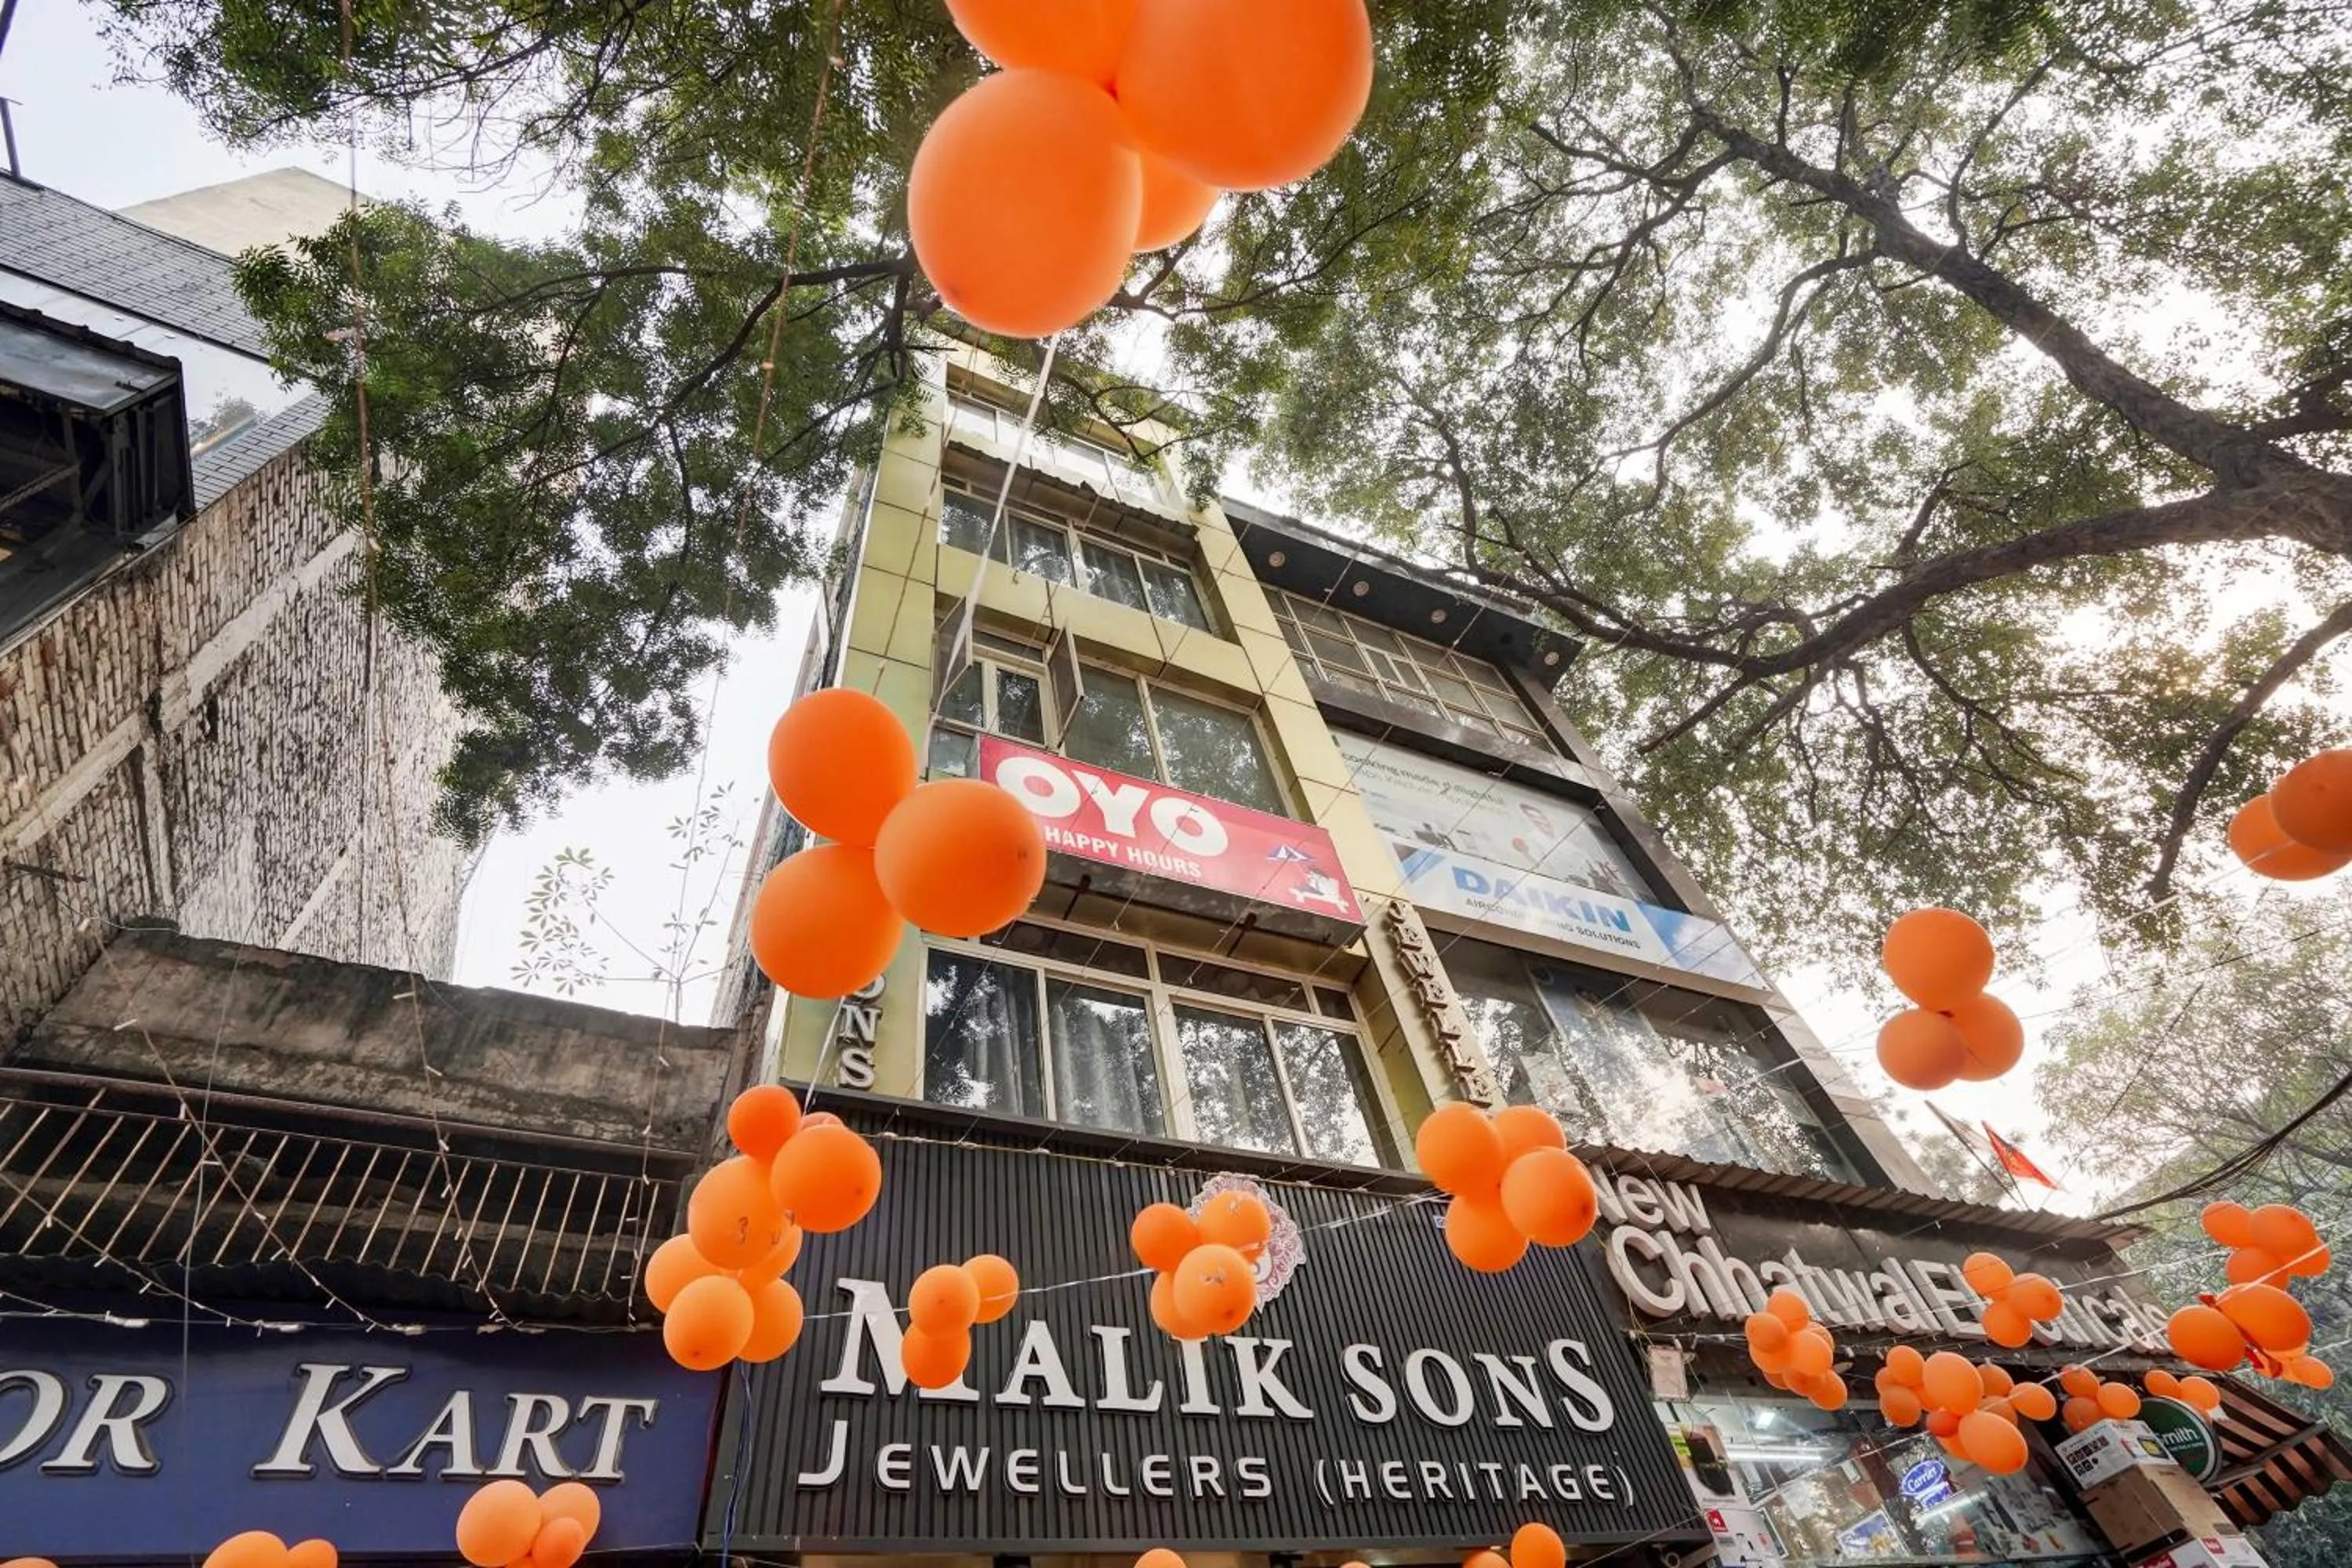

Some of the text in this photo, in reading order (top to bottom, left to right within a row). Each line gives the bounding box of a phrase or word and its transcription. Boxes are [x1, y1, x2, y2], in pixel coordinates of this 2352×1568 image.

[995, 757, 1229, 857] OYO
[1044, 825, 1203, 880] HAPPY HOURS
[1451, 866, 1632, 934] DAIKIN
[1592, 1163, 1711, 1235] New
[1606, 1225, 1944, 1334] Chhatwal
[819, 1277, 1617, 1434] MALIK SONS
[252, 1363, 659, 1479] KART
[797, 1419, 1635, 1508] JEWELLERS (HERITAGE)
